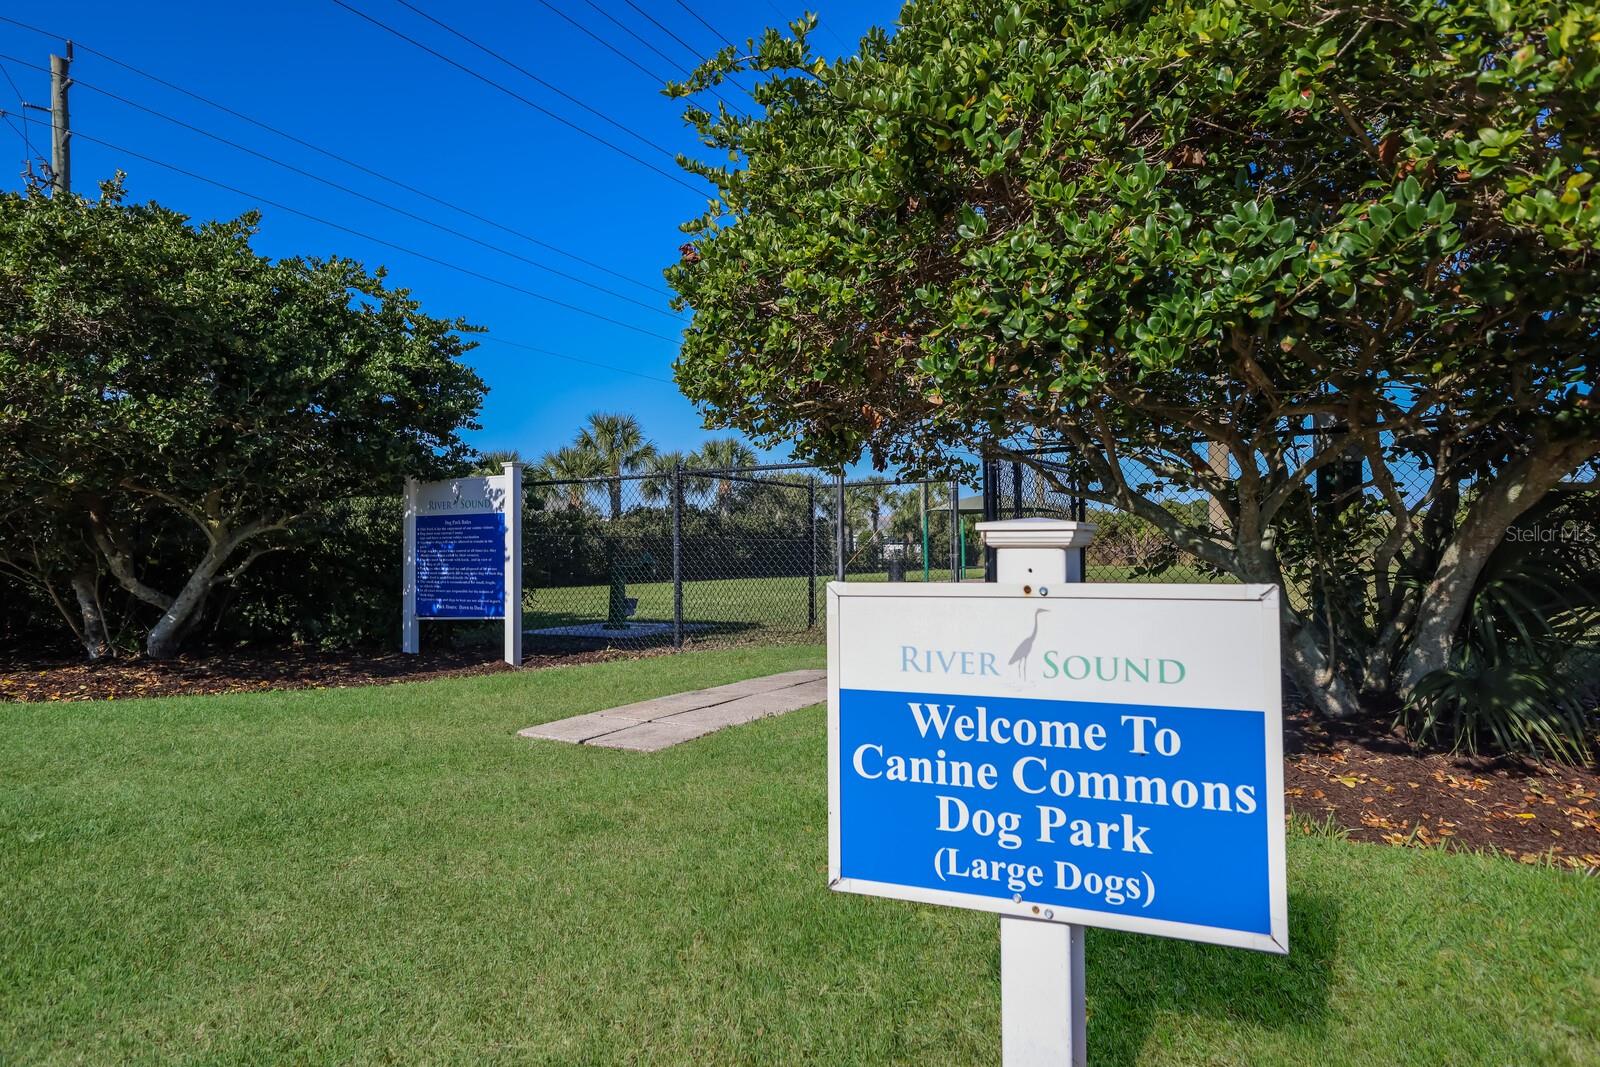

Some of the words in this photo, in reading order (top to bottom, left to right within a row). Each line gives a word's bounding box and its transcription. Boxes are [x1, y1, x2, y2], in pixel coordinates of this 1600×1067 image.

[900, 645, 1001, 676] RIVER
[1042, 650, 1186, 685] SOUND
[907, 702, 1107, 751] Welcome
[1121, 715, 1181, 757] To
[852, 743, 998, 790] Canine
[1012, 756, 1257, 815] Commons
[935, 795, 1022, 850] Dog
[1036, 805, 1153, 855] Park
[934, 847, 1043, 892] (Large
[1054, 860, 1155, 908] Dogs)
